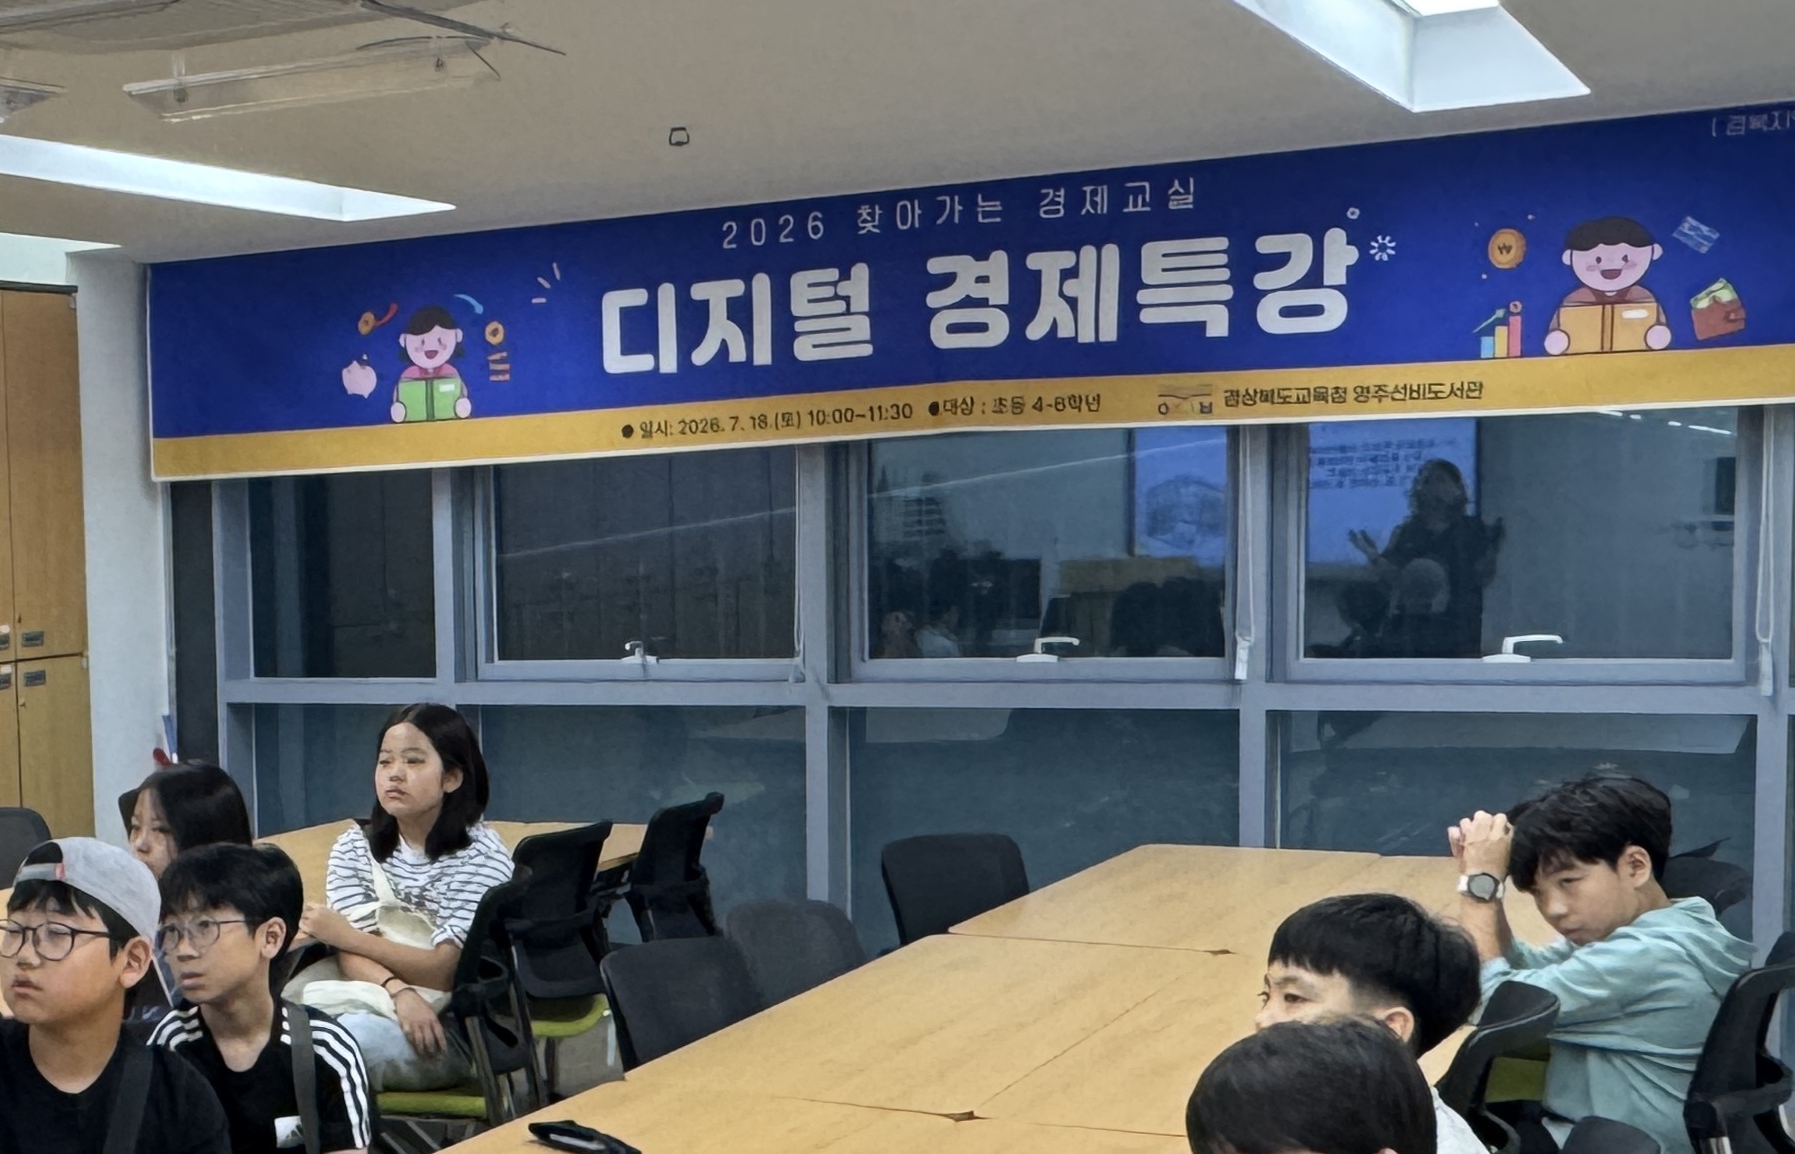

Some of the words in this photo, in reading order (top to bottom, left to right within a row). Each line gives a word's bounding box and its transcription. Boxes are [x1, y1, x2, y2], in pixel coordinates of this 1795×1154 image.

[721, 211, 825, 249] 2026
[857, 193, 1003, 235] 찾아가는
[1039, 176, 1196, 219] 경제교실
[601, 262, 874, 374] 디지털
[925, 227, 1360, 350] 경제특강
